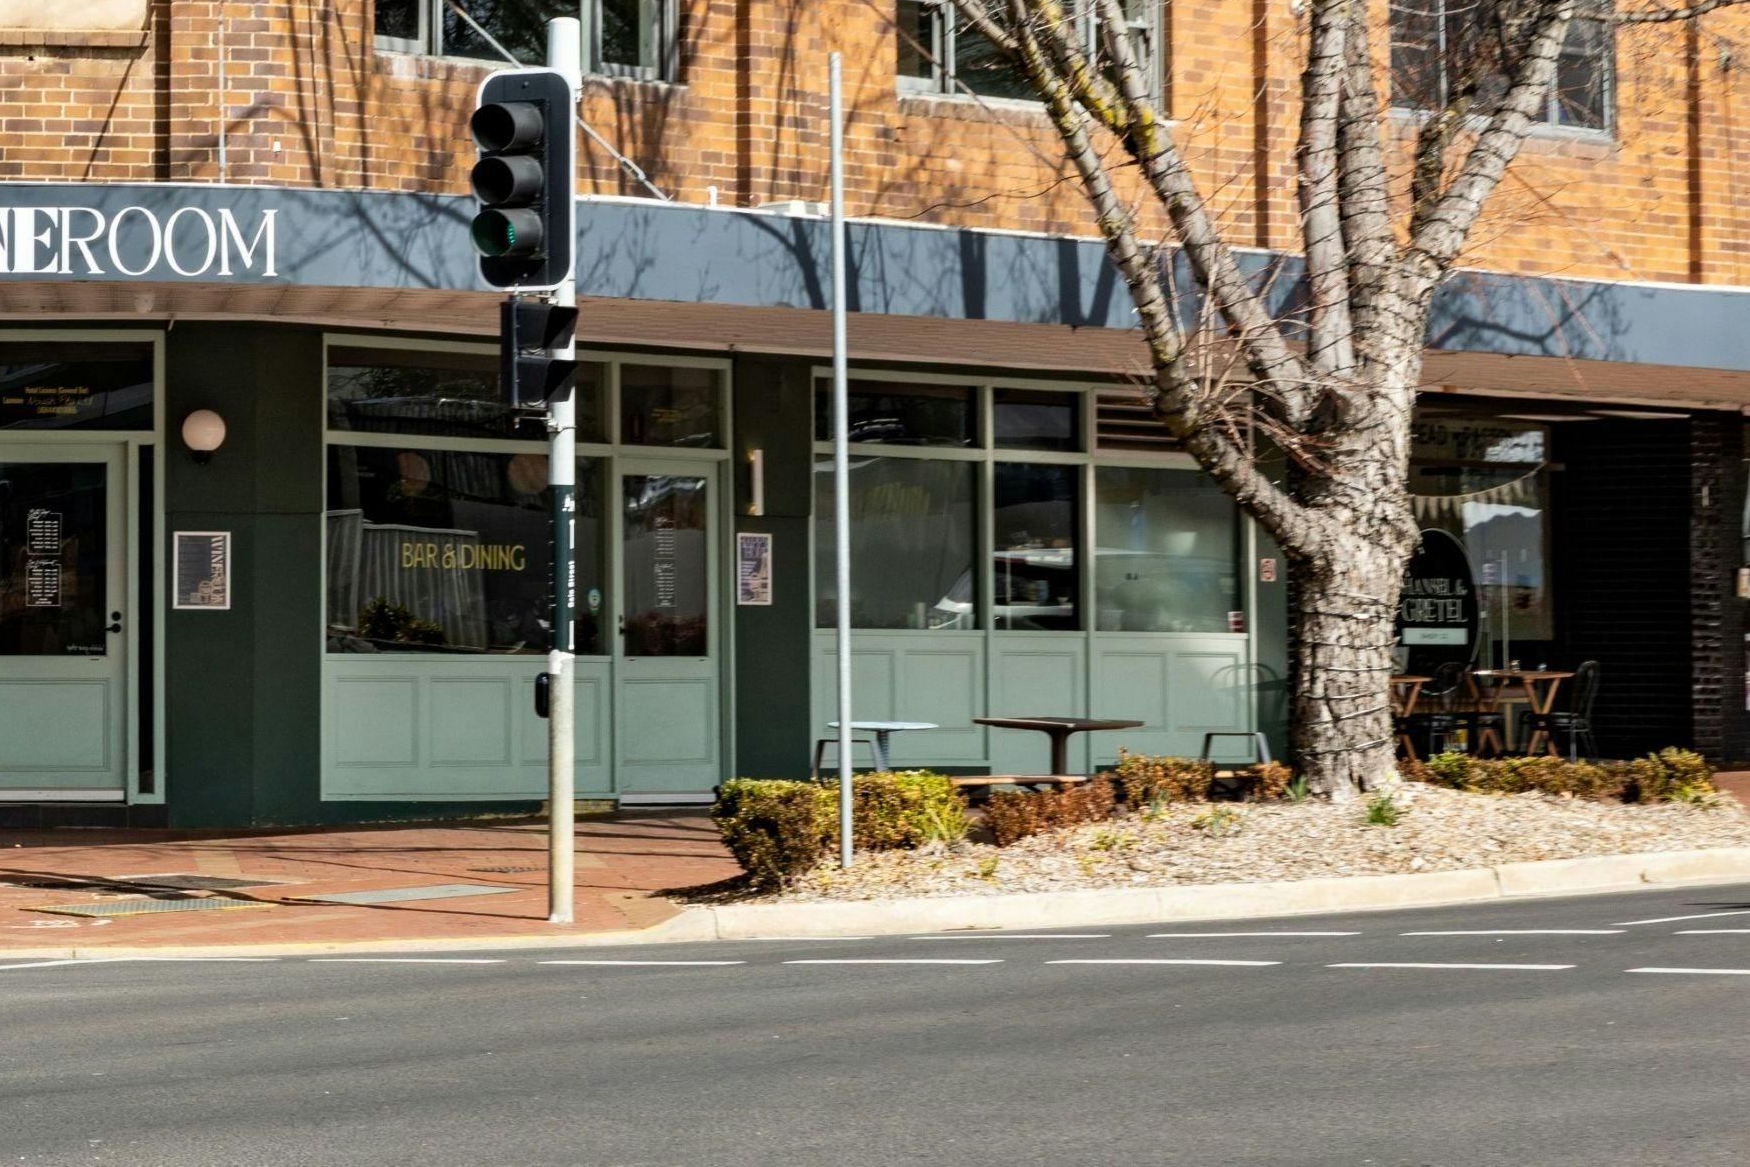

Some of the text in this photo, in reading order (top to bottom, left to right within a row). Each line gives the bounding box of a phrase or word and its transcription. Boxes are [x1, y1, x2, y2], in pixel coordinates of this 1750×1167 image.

[402, 543, 527, 571] BAR & DINING
[1401, 599, 1469, 622] GRETEL
